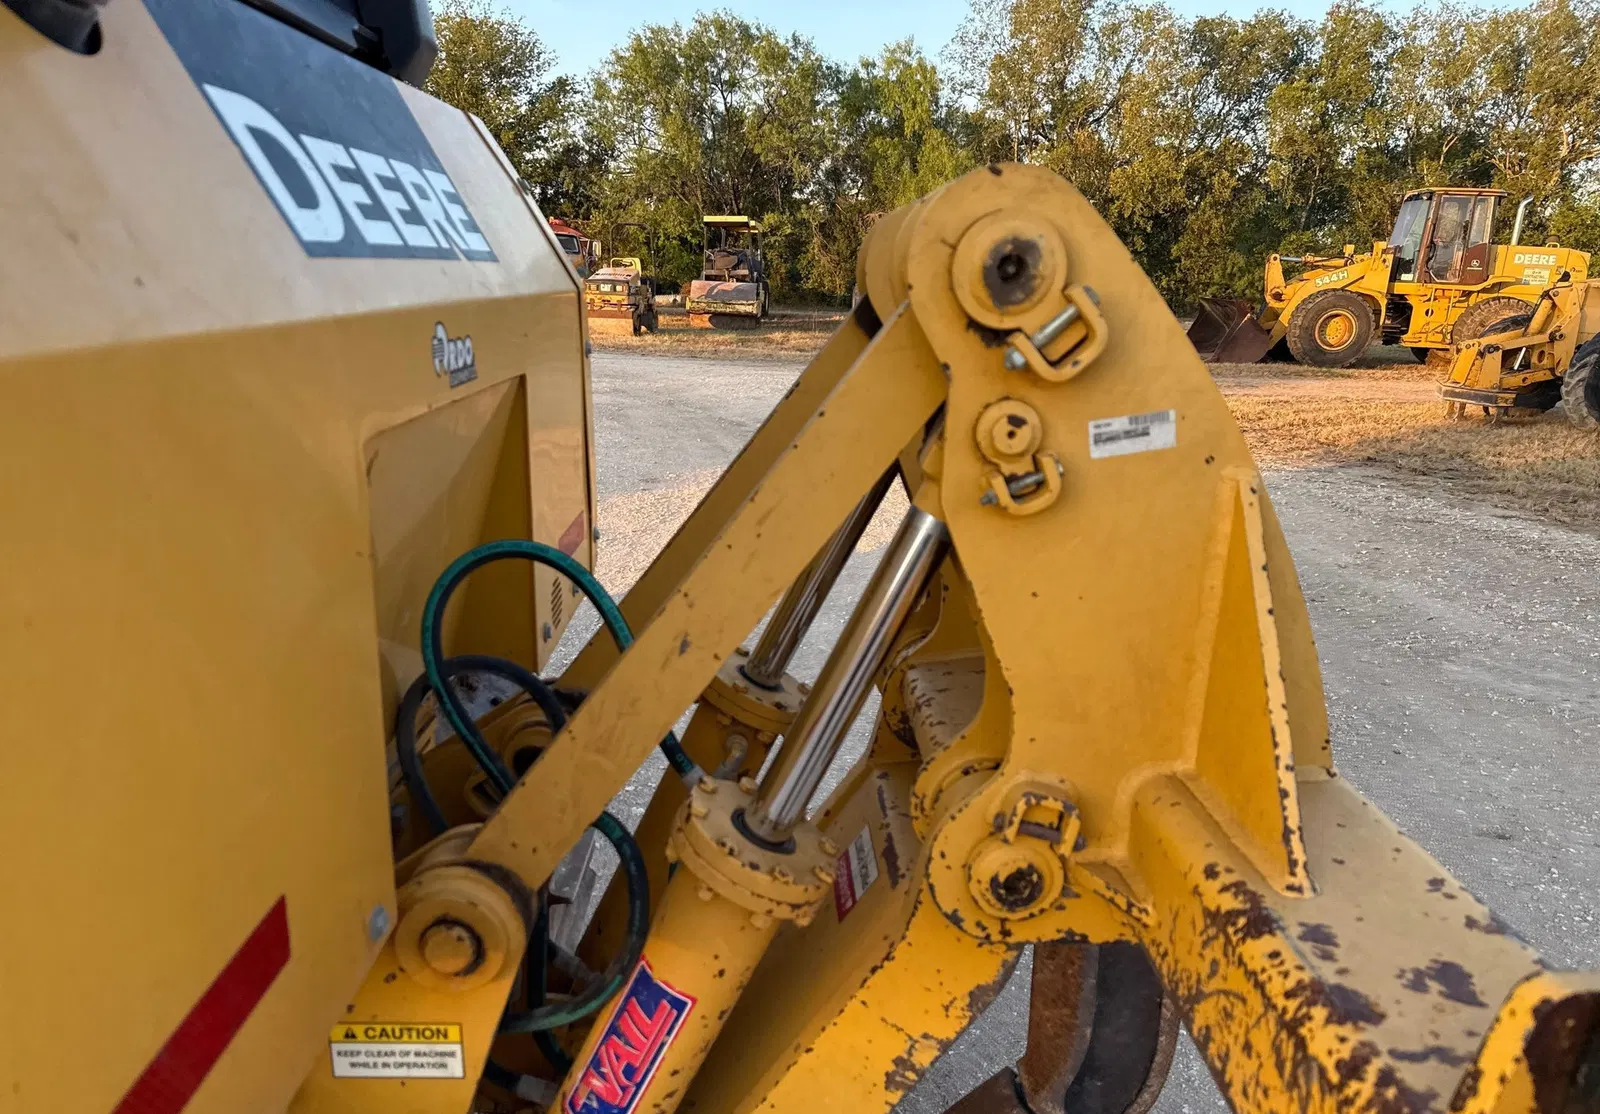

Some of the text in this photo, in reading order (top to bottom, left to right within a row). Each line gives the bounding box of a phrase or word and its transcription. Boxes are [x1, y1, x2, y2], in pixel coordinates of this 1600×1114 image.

[202, 83, 491, 251] DEERE
[1513, 253, 1557, 265] DEERE
[1315, 270, 1348, 287] 544H
[600, 283, 612, 292] CAT
[364, 1027, 448, 1040] CAUTION
[337, 1050, 457, 1059] KEEP CLEAR OF MACHINE
[573, 996, 678, 1112] VAIL
[349, 1061, 448, 1069] WHILE IN OPERATION
